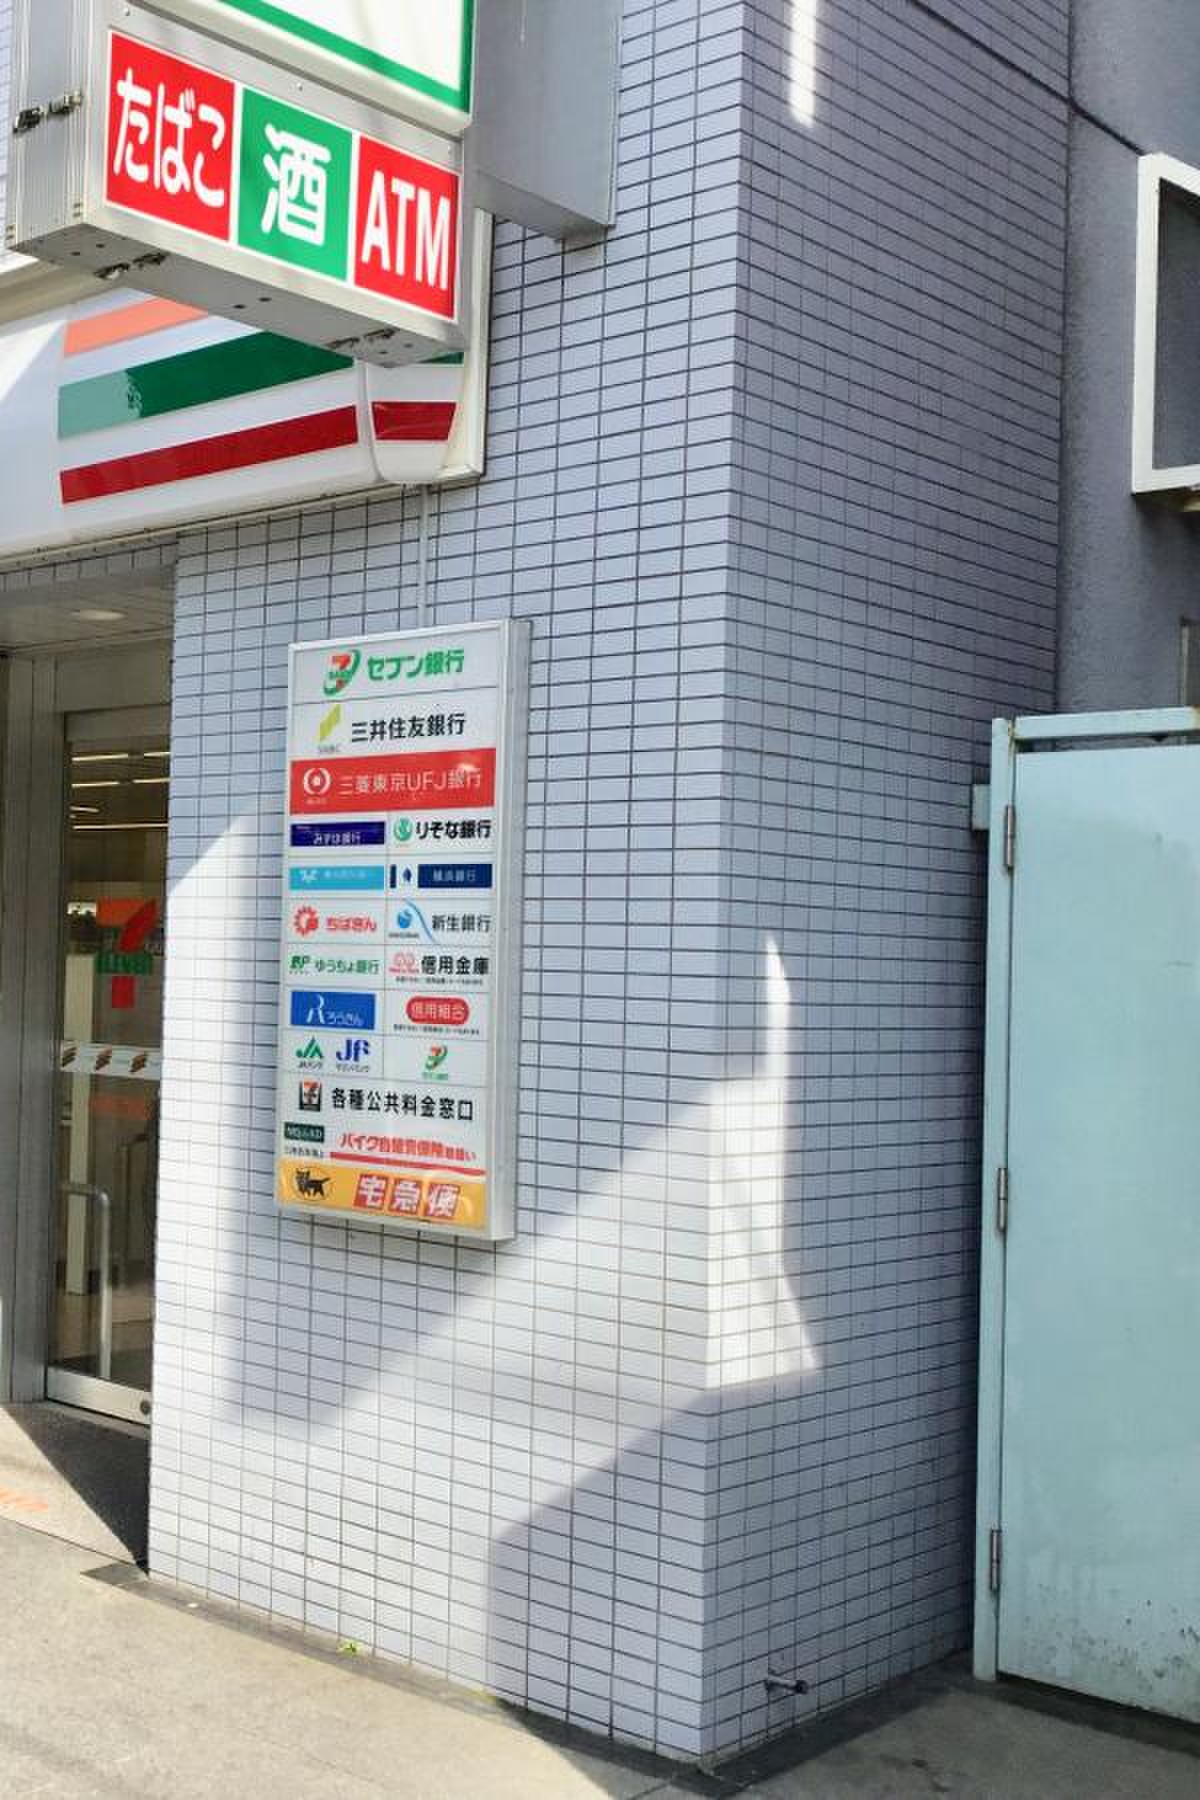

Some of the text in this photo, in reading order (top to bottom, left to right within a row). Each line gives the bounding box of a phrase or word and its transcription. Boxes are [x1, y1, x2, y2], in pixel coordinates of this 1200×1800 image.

[113, 67, 226, 208] たばこ
[260, 123, 331, 246] 酒
[362, 169, 451, 291] ATM
[367, 649, 465, 681] セブン銀行
[351, 713, 466, 743] 三井住友銀行
[338, 768, 482, 796] 三菱東京UFJ銀行
[415, 819, 492, 841] りそな銀行
[432, 914, 491, 933] 新生銀行
[315, 959, 380, 975] ゆうちょ銀行
[421, 954, 490, 976] 信用金庫
[411, 1001, 466, 1021] 信用組合
[331, 1087, 473, 1121] 各種公共料金窓口
[356, 1175, 459, 1217] 宅急便
